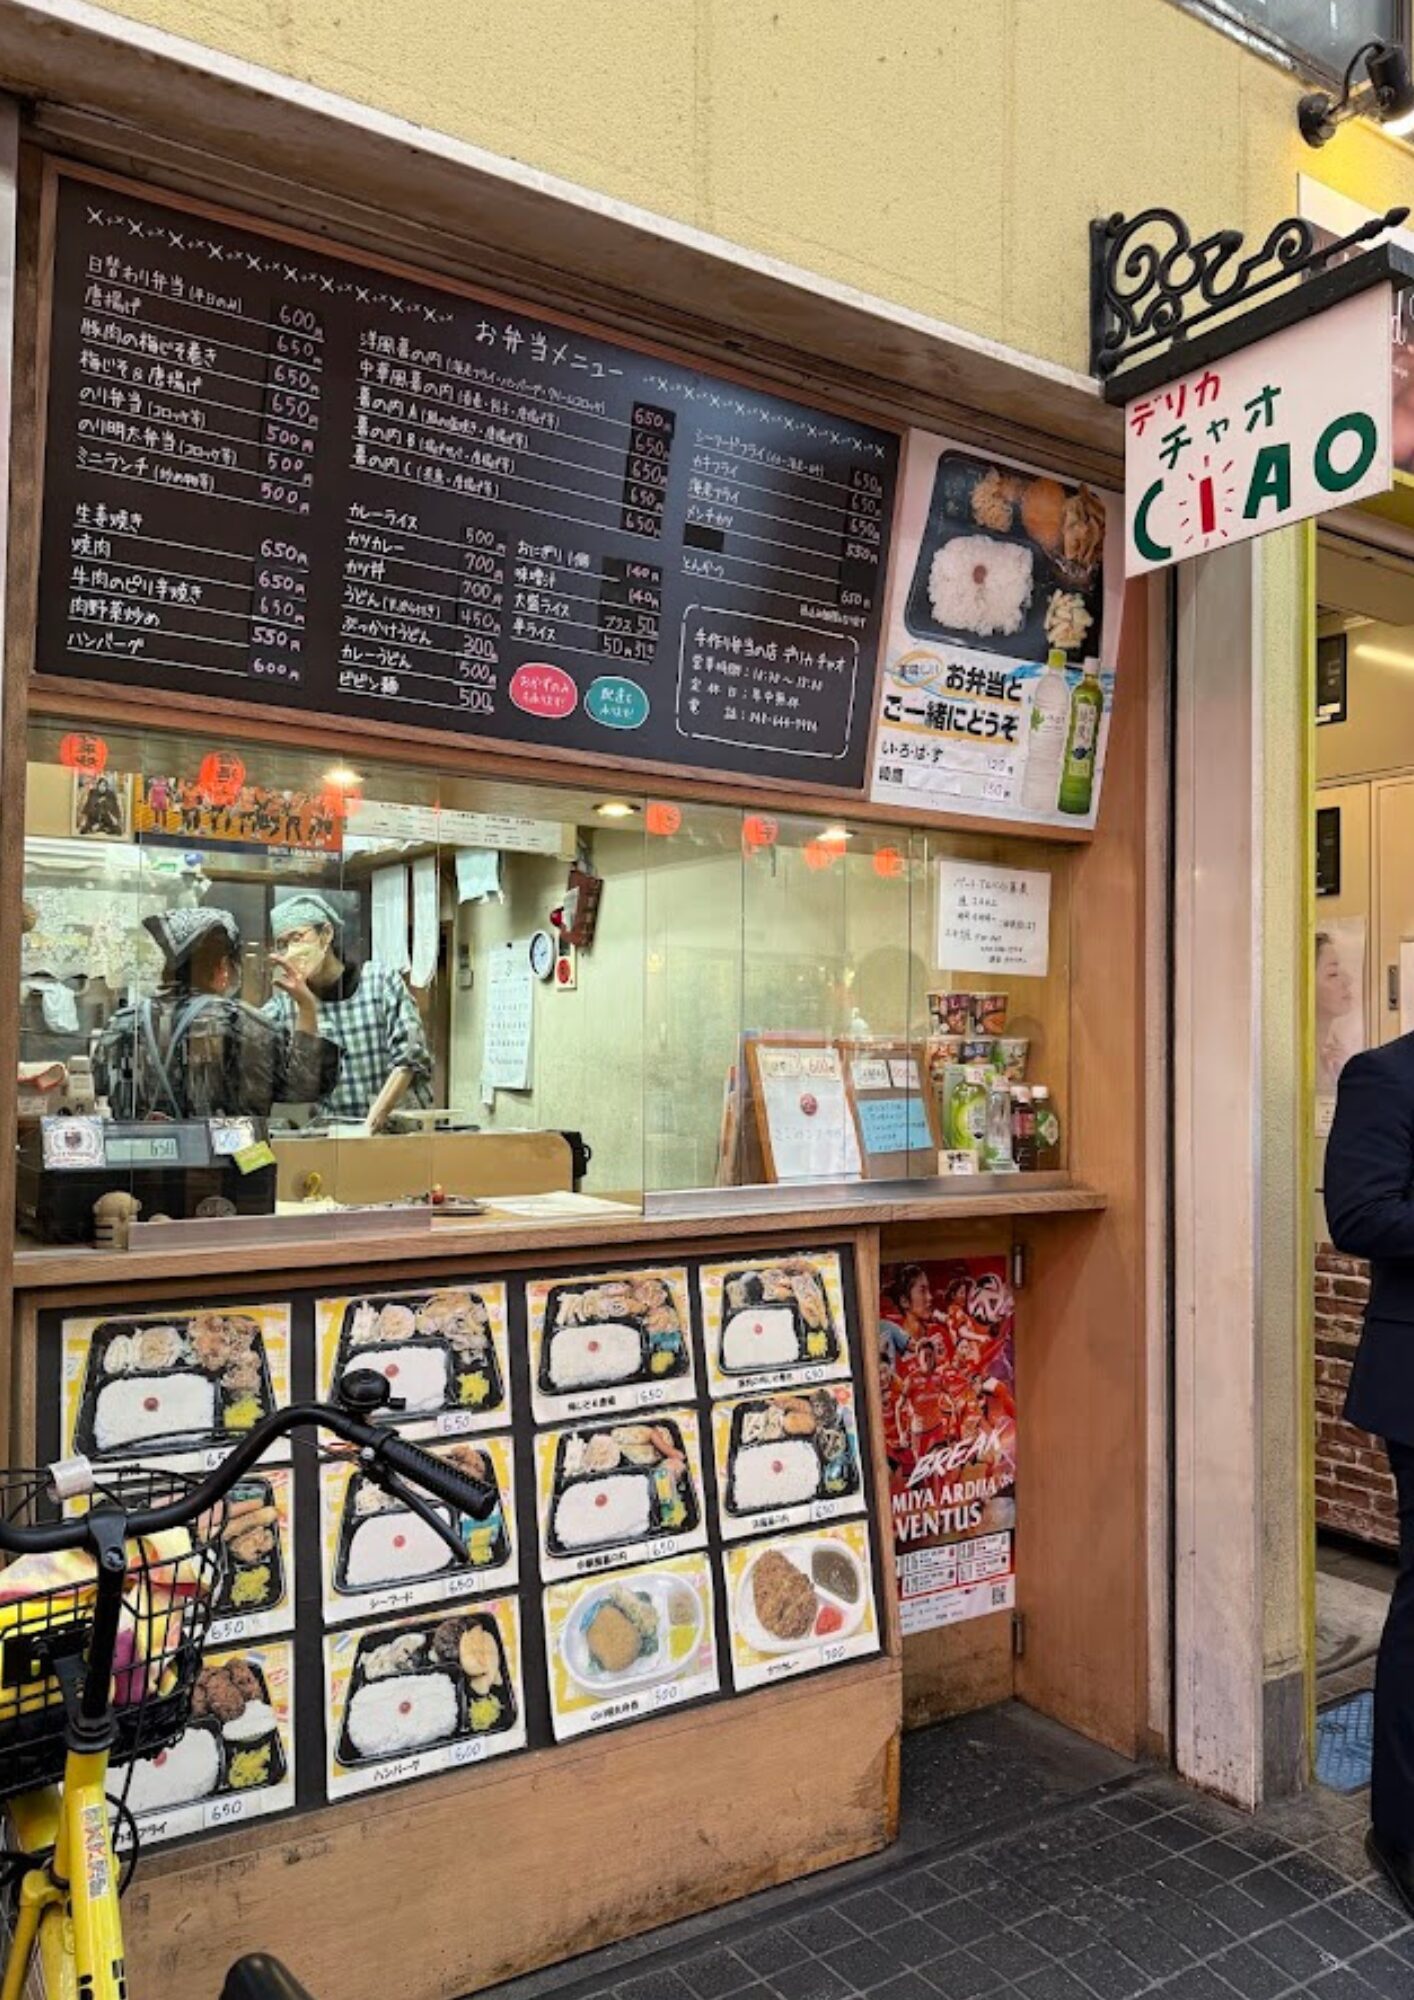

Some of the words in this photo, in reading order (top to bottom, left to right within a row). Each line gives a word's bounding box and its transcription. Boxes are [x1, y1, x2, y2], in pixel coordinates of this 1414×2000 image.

[84, 283, 141, 316] 唐揚げ
[277, 334, 322, 366] 650円
[279, 304, 325, 337] 600円
[475, 320, 623, 378] お弁当メニュー
[274, 363, 320, 395] 650円
[272, 392, 319, 426] 650円
[1130, 370, 1221, 436] デリカ
[267, 423, 314, 453] 500円
[1159, 385, 1281, 469] チャオ
[267, 452, 313, 486] 500円
[261, 482, 309, 515] 500円
[1133, 412, 1377, 561] CIAO
[349, 503, 419, 531] カレーライス
[261, 539, 309, 566] 650円
[258, 570, 305, 595] 650円
[259, 597, 305, 624] 650円
[252, 626, 301, 652] 550円
[67, 631, 145, 655] ハンバーグ
[253, 658, 299, 681] 600円
[341, 644, 412, 670] カレーうどん
[947, 663, 1023, 702] お弁当と
[883, 695, 1019, 742] ご一緒にどうぞ
[443, 1414, 470, 1434] 650
[905, 1429, 1000, 1488] BREAK
[892, 1488, 935, 1515] MIYA
[895, 1501, 981, 1542] VENTUS
[651, 1539, 676, 1557] 650
[449, 1576, 474, 1594] 650
[211, 1619, 245, 1640] 650
[211, 1800, 242, 1821] 650
